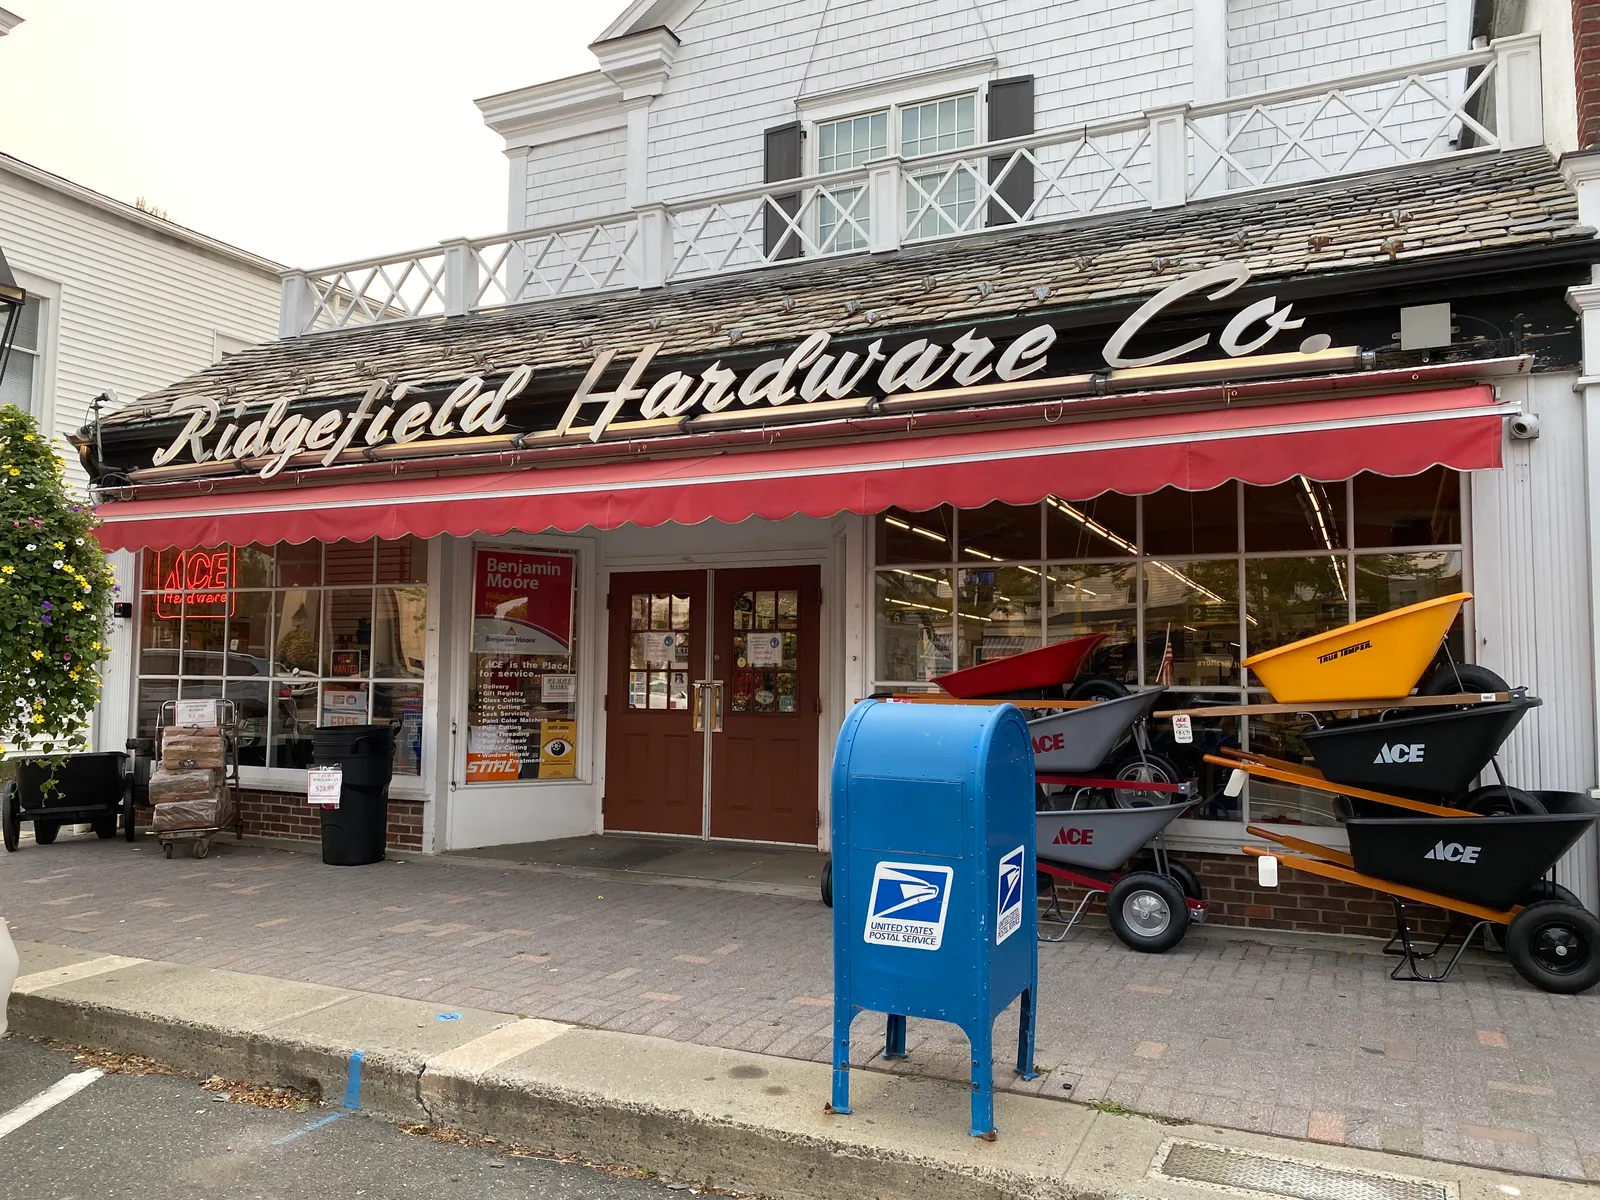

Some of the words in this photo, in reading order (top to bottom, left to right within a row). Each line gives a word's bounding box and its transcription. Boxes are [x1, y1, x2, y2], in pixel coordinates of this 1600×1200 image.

[151, 364, 535, 479] Ridgefield
[554, 323, 1057, 443] Hardware
[1102, 260, 1332, 368] Co.
[164, 550, 229, 590] ACE
[487, 557, 561, 577] Benjamin
[486, 573, 539, 590] Moore
[163, 592, 227, 605] Hadware
[485, 636, 515, 644] Benjamin
[337, 653, 354, 662] HELP
[1317, 650, 1338, 664] TRUE
[333, 664, 359, 674] WANTED
[509, 661, 518, 669] is
[522, 661, 538, 669] the
[542, 661, 568, 670] Place
[479, 670, 493, 678] for
[1031, 732, 1065, 754] ACE
[1373, 742, 1425, 764] ACE
[1053, 825, 1094, 845] ACE
[1423, 839, 1482, 864] ACE
[870, 921, 903, 932] UNITED
[903, 925, 934, 936] STATES
[869, 931, 901, 942] POSTAL
[901, 934, 937, 946] SERVICE
